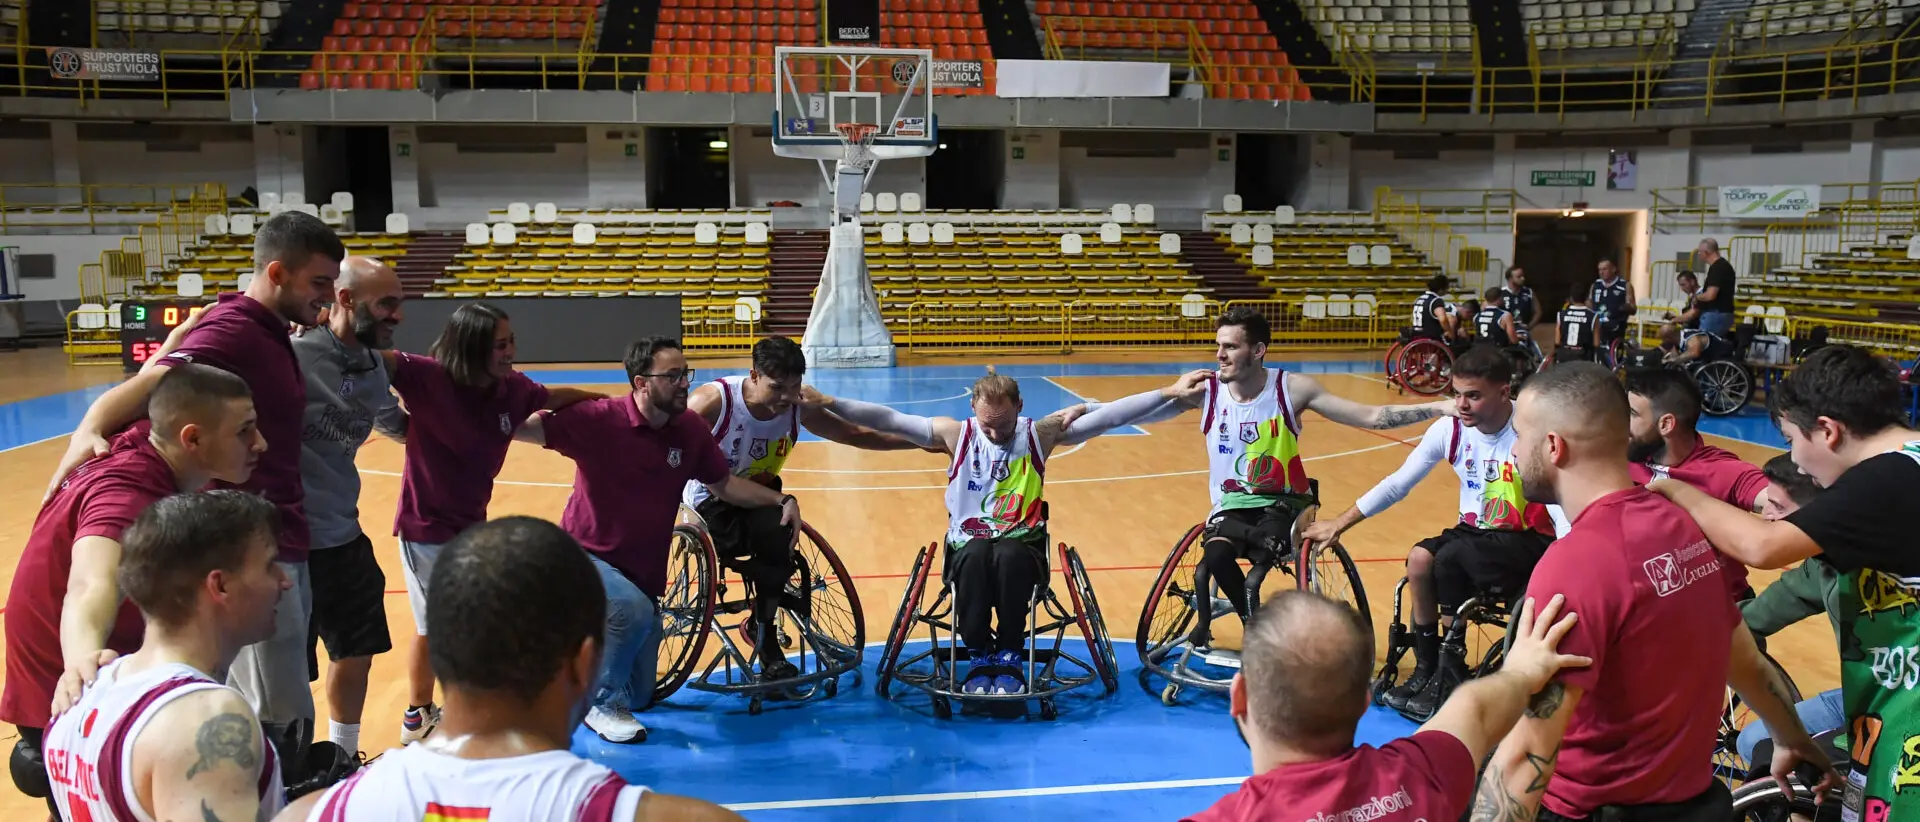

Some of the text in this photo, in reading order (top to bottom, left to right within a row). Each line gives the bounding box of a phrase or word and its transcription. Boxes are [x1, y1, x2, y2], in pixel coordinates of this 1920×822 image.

[83, 51, 159, 63] SUPPORTERS
[85, 62, 158, 74] TRUST VIOLA
[931, 61, 982, 72] PPORTERS
[952, 72, 981, 82] VIOLA
[813, 101, 821, 112] 3
[1724, 192, 1769, 200] TOURING
[136, 307, 145, 320] 3
[125, 322, 146, 330] HOME
[1867, 645, 1920, 691] BOS
